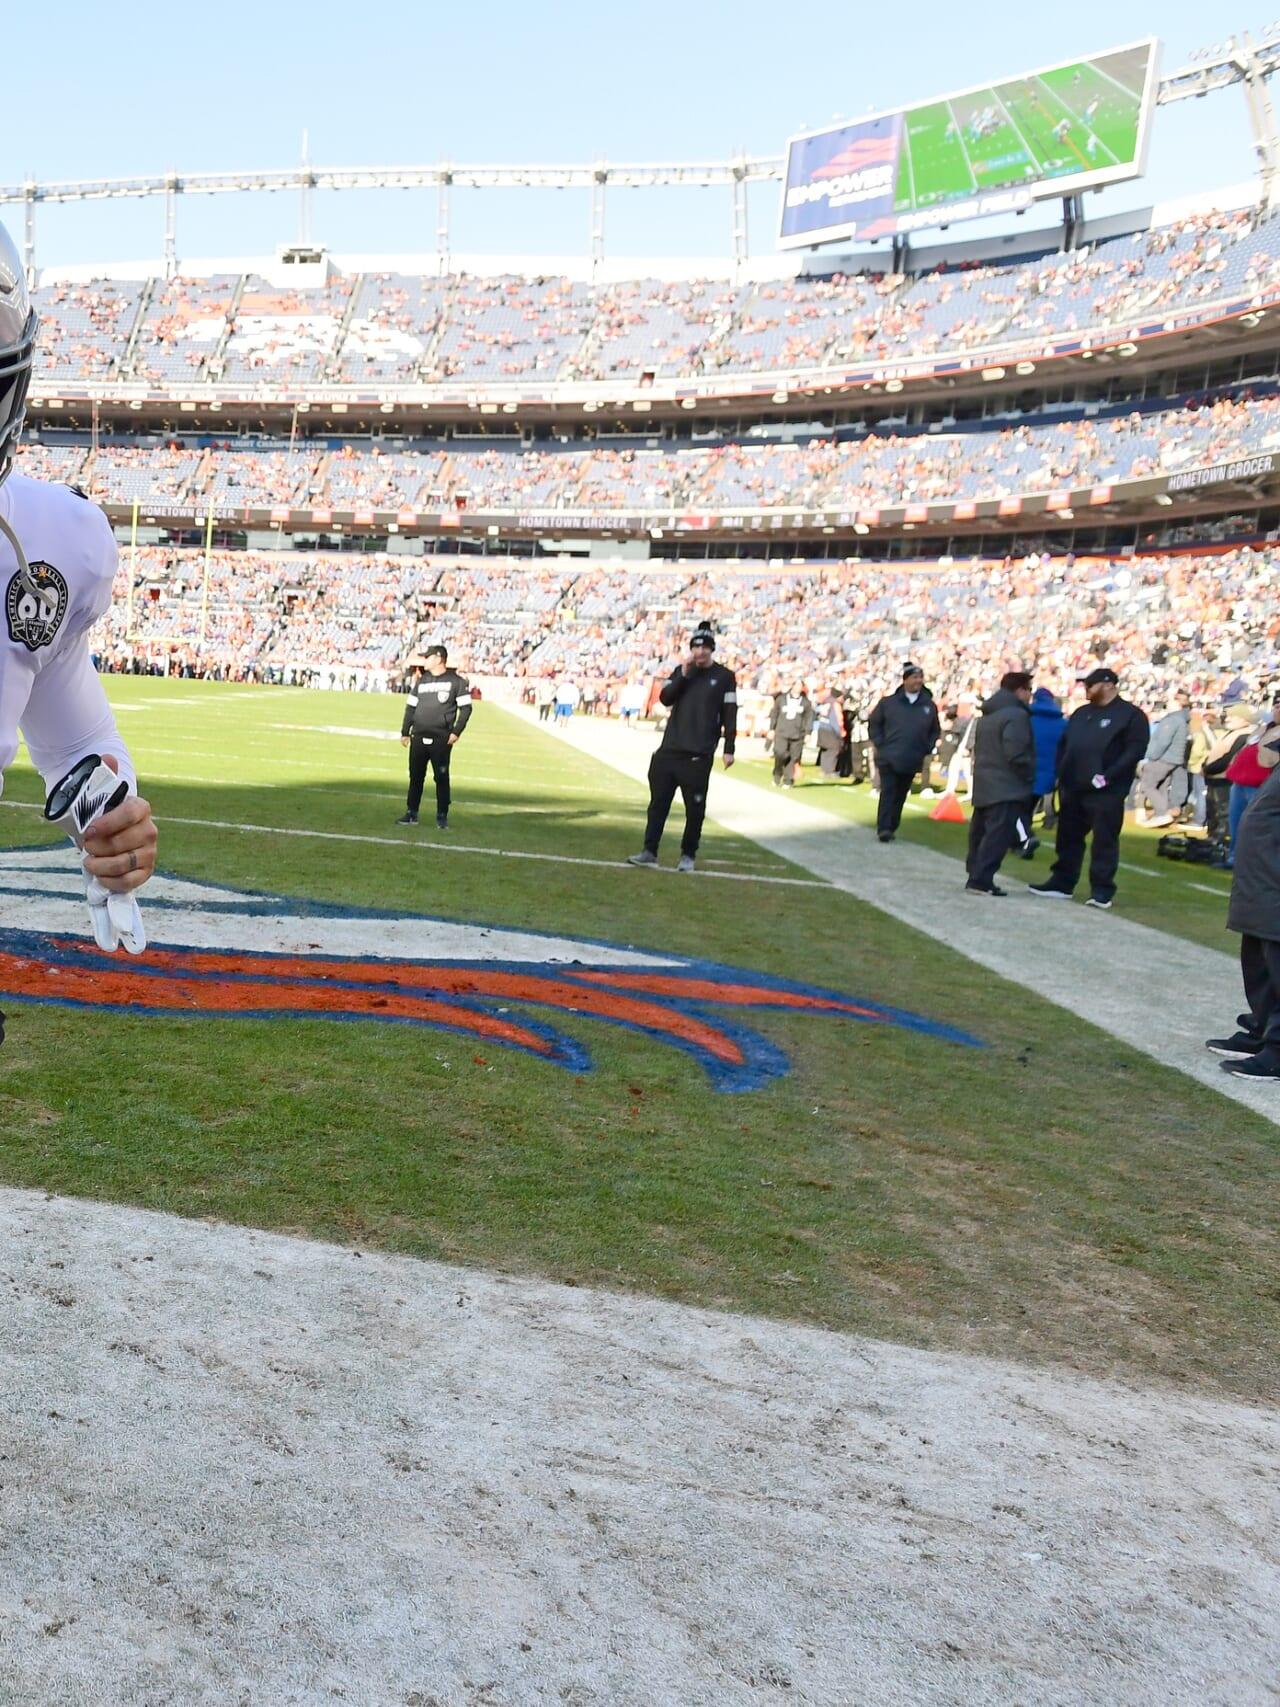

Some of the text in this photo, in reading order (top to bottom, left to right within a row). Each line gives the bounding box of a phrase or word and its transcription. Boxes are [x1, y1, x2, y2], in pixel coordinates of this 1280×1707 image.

[1168, 456, 1275, 491] HOMETOWN GROCER.
[140, 506, 196, 518] HOMETOWN
[518, 516, 581, 529] HOMETOWN
[582, 517, 631, 529] GROCER.
